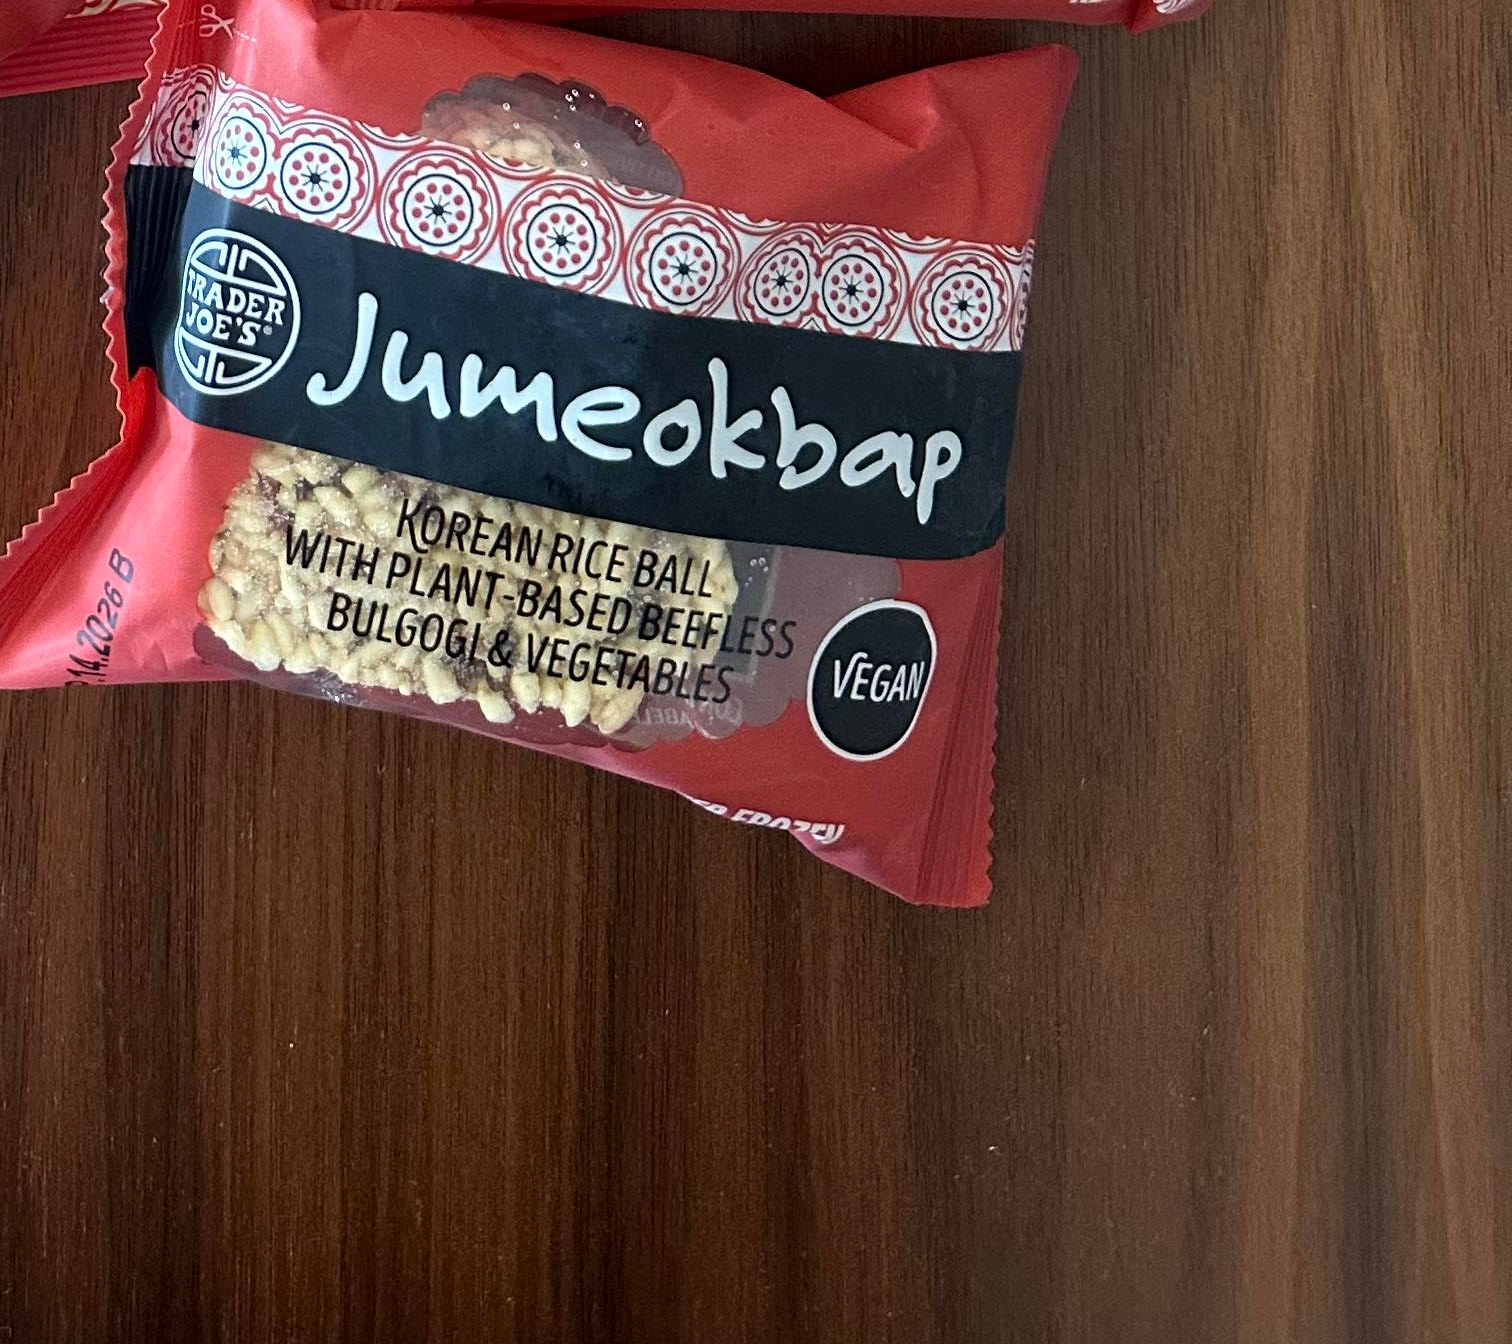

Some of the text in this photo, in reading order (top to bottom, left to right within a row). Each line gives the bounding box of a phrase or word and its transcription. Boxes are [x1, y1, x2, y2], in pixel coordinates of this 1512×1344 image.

[185, 270, 285, 327] TRADER
[305, 292, 962, 524] Jumeokbap
[109, 548, 134, 583] B
[286, 526, 795, 659] WITH PLANT-BASED BEEFLESS
[396, 498, 712, 599] KOREAN RICE BALL
[327, 592, 734, 705] BULGOGI & VEGETABLES
[831, 653, 925, 703] VEGAN
